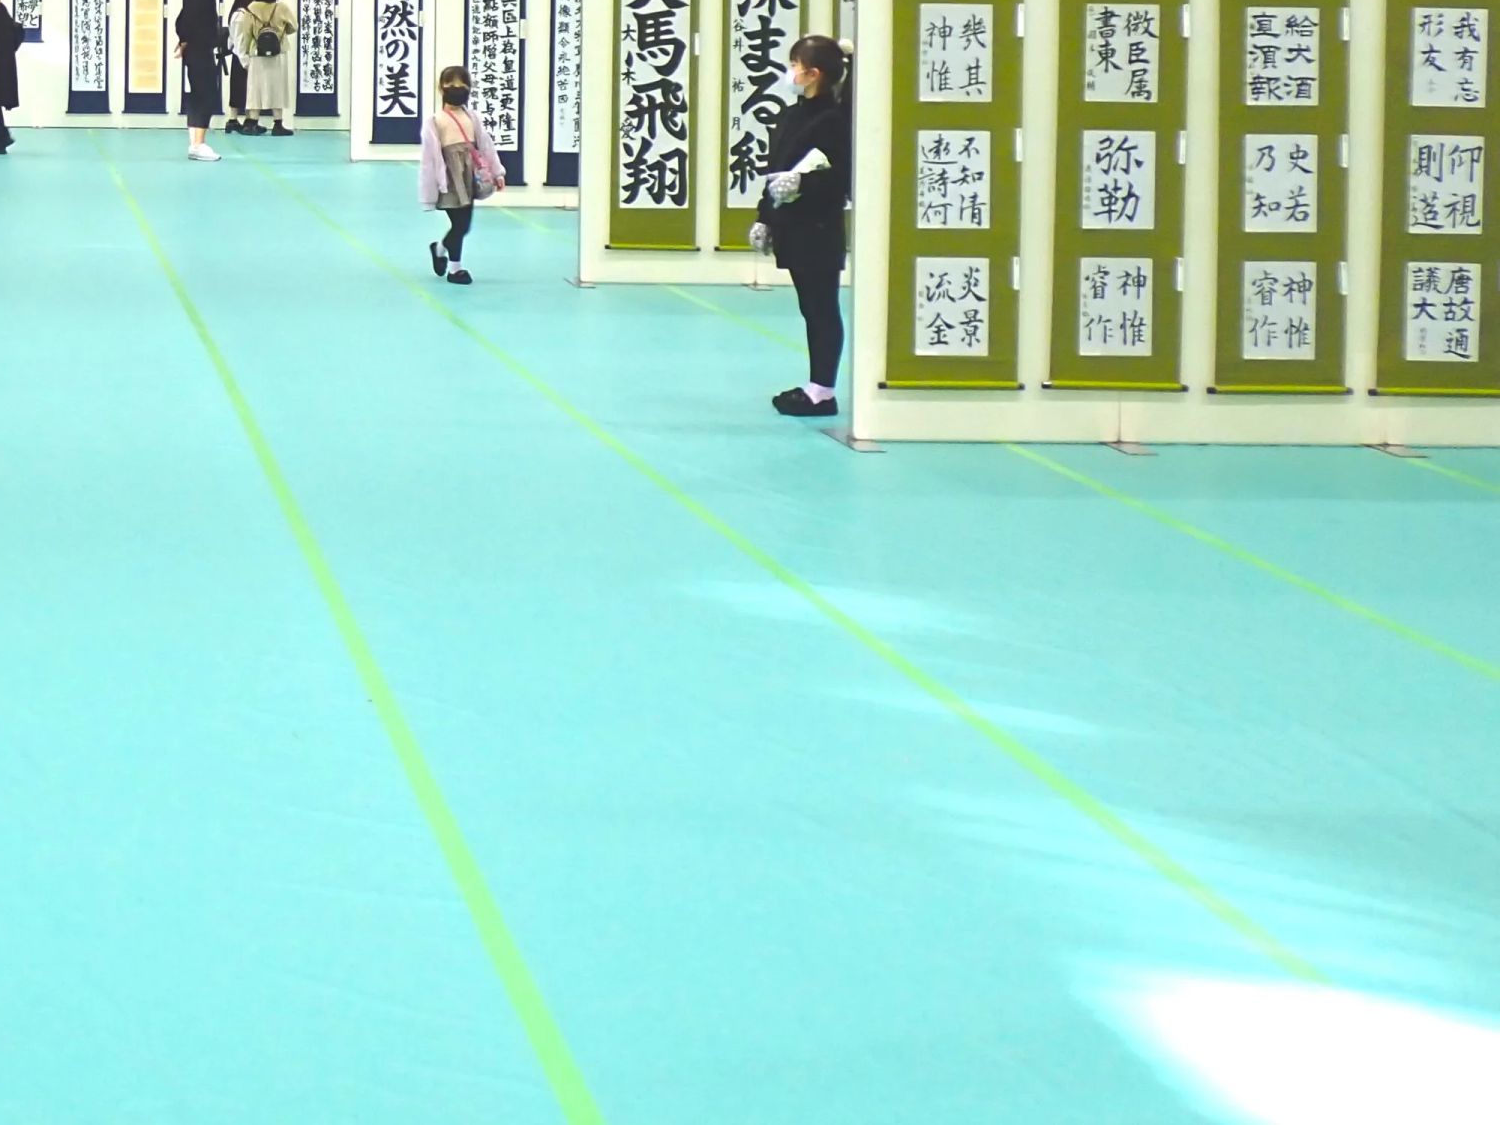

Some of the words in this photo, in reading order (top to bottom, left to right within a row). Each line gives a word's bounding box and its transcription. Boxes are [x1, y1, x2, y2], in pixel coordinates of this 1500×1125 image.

[1452, 11, 1480, 102] 我有忘
[1252, 145, 1281, 218] 乃知
[925, 272, 956, 345] 流金
[958, 266, 986, 347] 炎景
[1412, 267, 1442, 321] 議大
[1443, 266, 1476, 359] 唐故通
